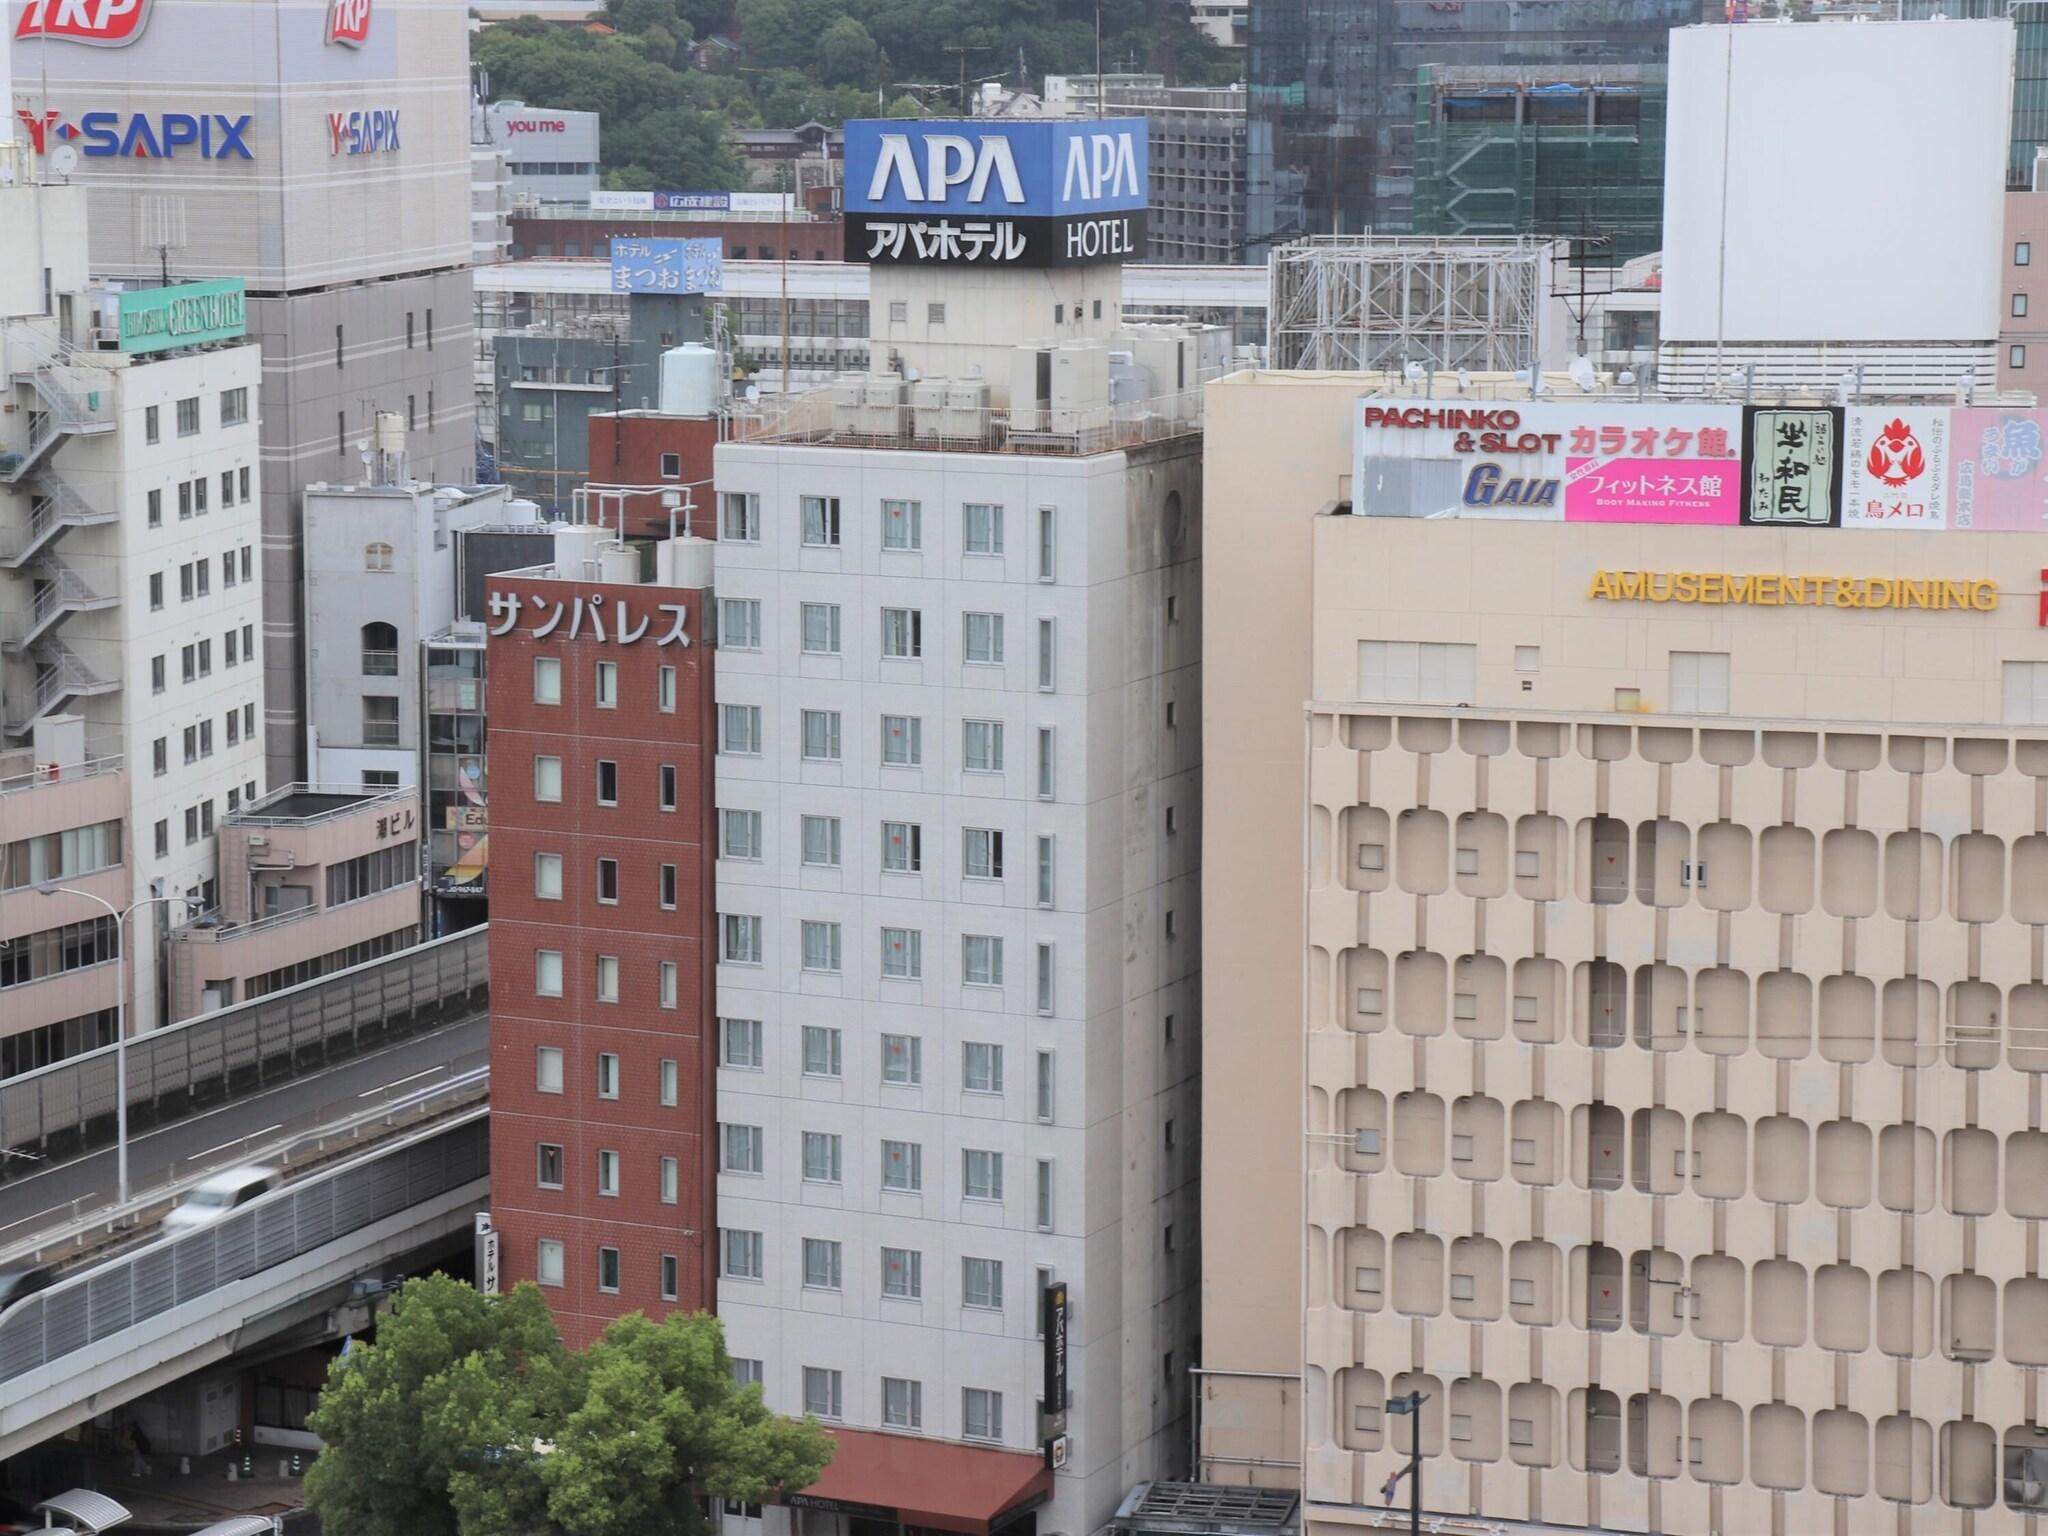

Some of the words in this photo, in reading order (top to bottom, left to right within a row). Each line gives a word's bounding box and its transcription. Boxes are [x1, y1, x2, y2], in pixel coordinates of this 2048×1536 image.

[867, 133, 1026, 203] APA
[1063, 133, 1140, 202] APA
[615, 243, 652, 258] ホテル
[865, 219, 1027, 261] アパホテル
[1066, 218, 1134, 258] HOTEL
[615, 265, 680, 290] まつお
[1365, 406, 1521, 431] PACHINKO
[1454, 431, 1476, 453] &
[1480, 432, 1562, 455] SLOT
[1586, 475, 1723, 497] フィットネス館
[1865, 500, 1924, 519] 鳥メロ
[488, 591, 691, 648] サンパレス
[1055, 1307, 1065, 1377] アパホテル
